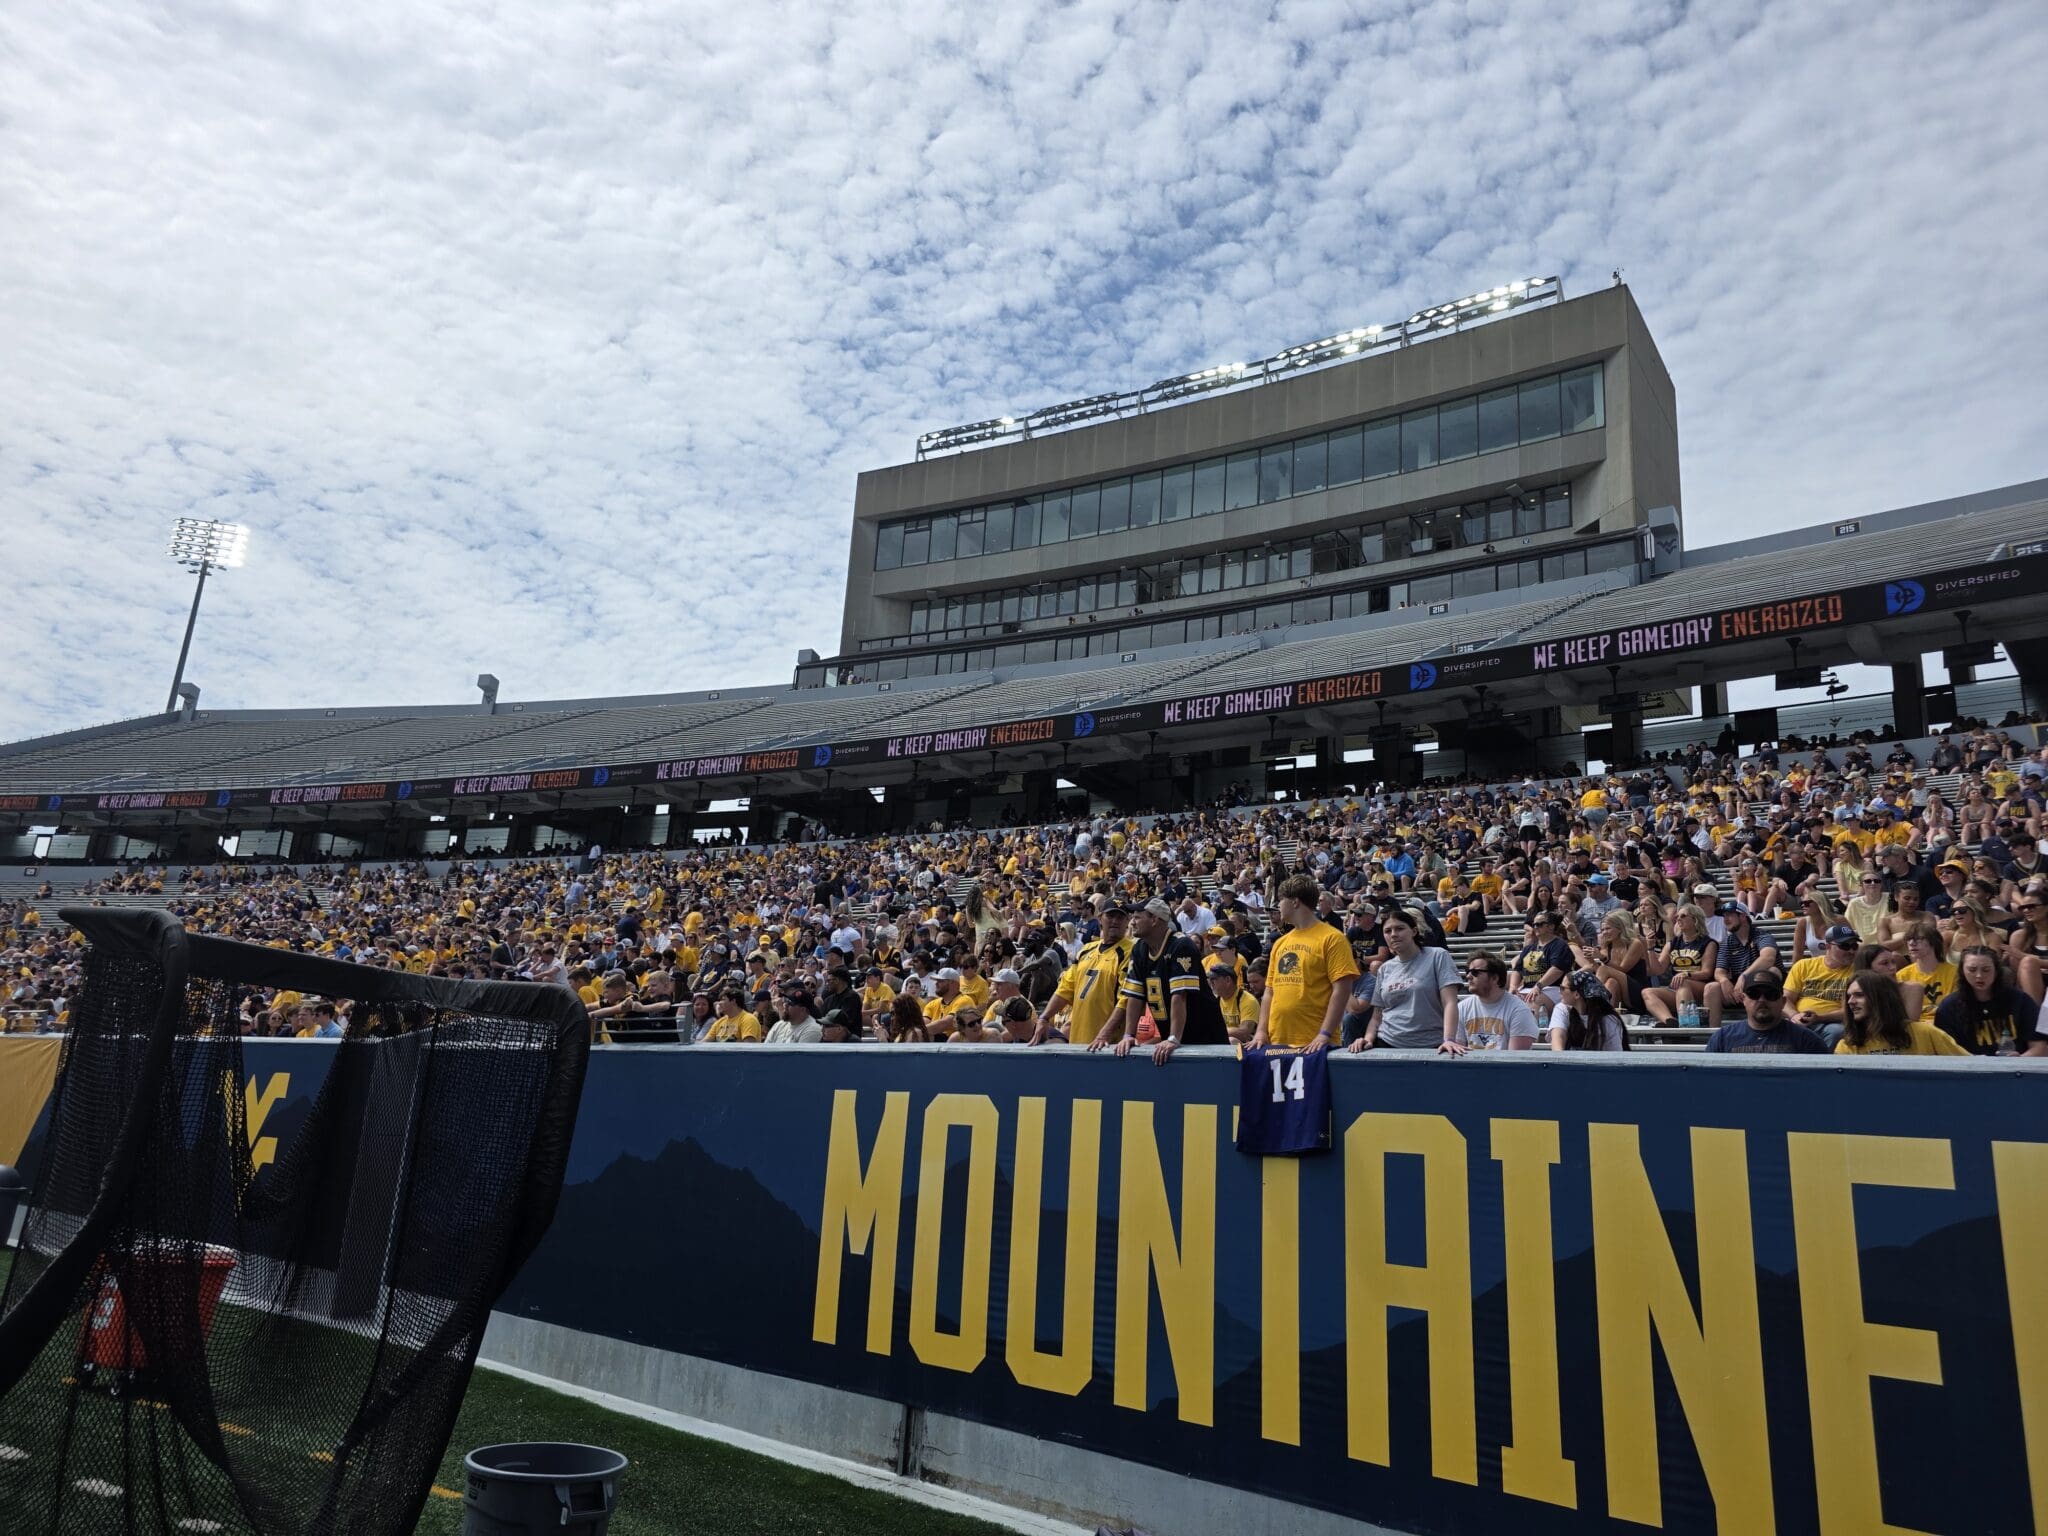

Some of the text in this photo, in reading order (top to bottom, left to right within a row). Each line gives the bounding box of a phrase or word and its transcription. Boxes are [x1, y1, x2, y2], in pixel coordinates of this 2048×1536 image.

[1839, 524, 1855, 535] 215
[2015, 544, 2043, 557] 215
[1935, 569, 2021, 592] DIVERSIFIED
[1432, 605, 1445, 614] 216
[1533, 594, 1844, 670] WE KEEP GAMEDAY ENERGIZED
[1443, 658, 1501, 673] DIVERSIFIED
[1164, 671, 1382, 724] WE KEEP GAMEDAY ENERGIZED
[1099, 711, 1142, 724] DIVERSIFIED
[887, 719, 1054, 758] WE KEEP GAMEDAY ENERGIZED
[656, 750, 800, 780] WE KEEP GAMEDAY ENERGIZED
[269, 783, 387, 804] WE KEEP GAMEDAY ENERGIZED
[453, 779, 467, 795] WE
[466, 777, 489, 793] KEEP
[490, 774, 531, 792] GAMEDAY
[532, 770, 580, 789] ENERGIZED
[97, 795, 109, 809] WE
[109, 794, 129, 808] KEEP
[129, 793, 166, 808] GAMEDAY
[1080, 968, 1099, 1000] 7
[1270, 1056, 1305, 1103] 14
[812, 1088, 2048, 1536] MOUNTAINE
